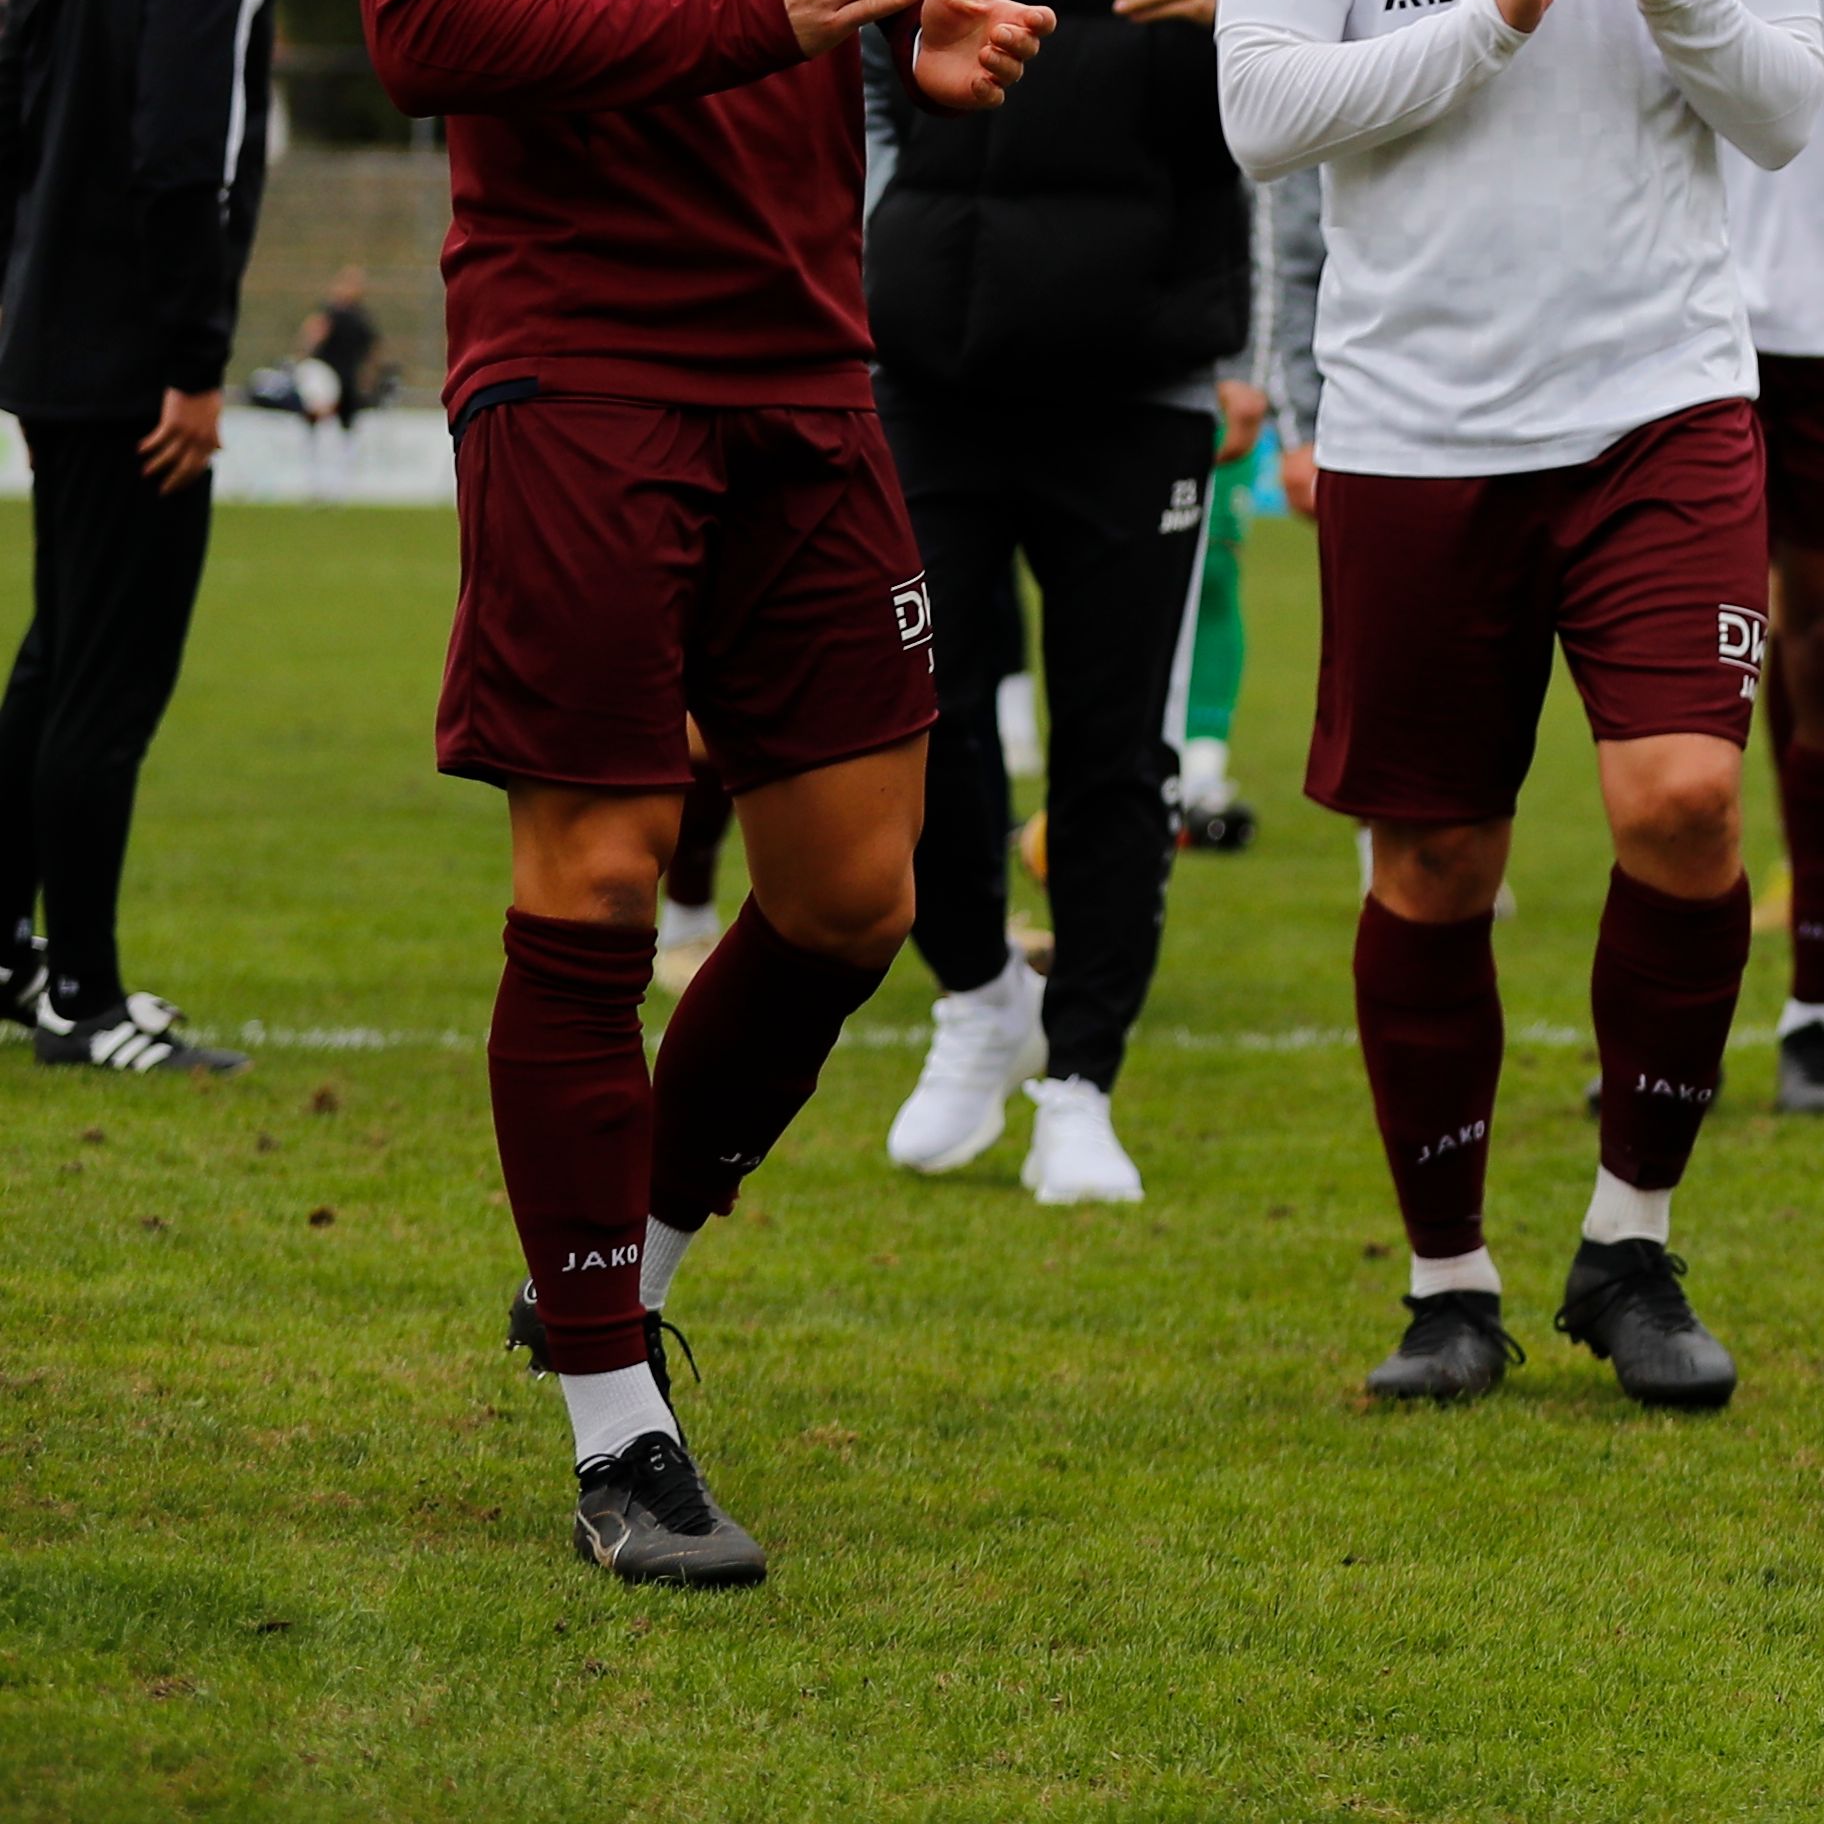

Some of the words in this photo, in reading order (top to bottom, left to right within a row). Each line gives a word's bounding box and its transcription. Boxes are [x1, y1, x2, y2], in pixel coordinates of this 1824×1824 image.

[1635, 1074, 1714, 1104] JAKO
[1417, 1119, 1486, 1164] JAKO
[561, 1243, 639, 1273] JAKO
